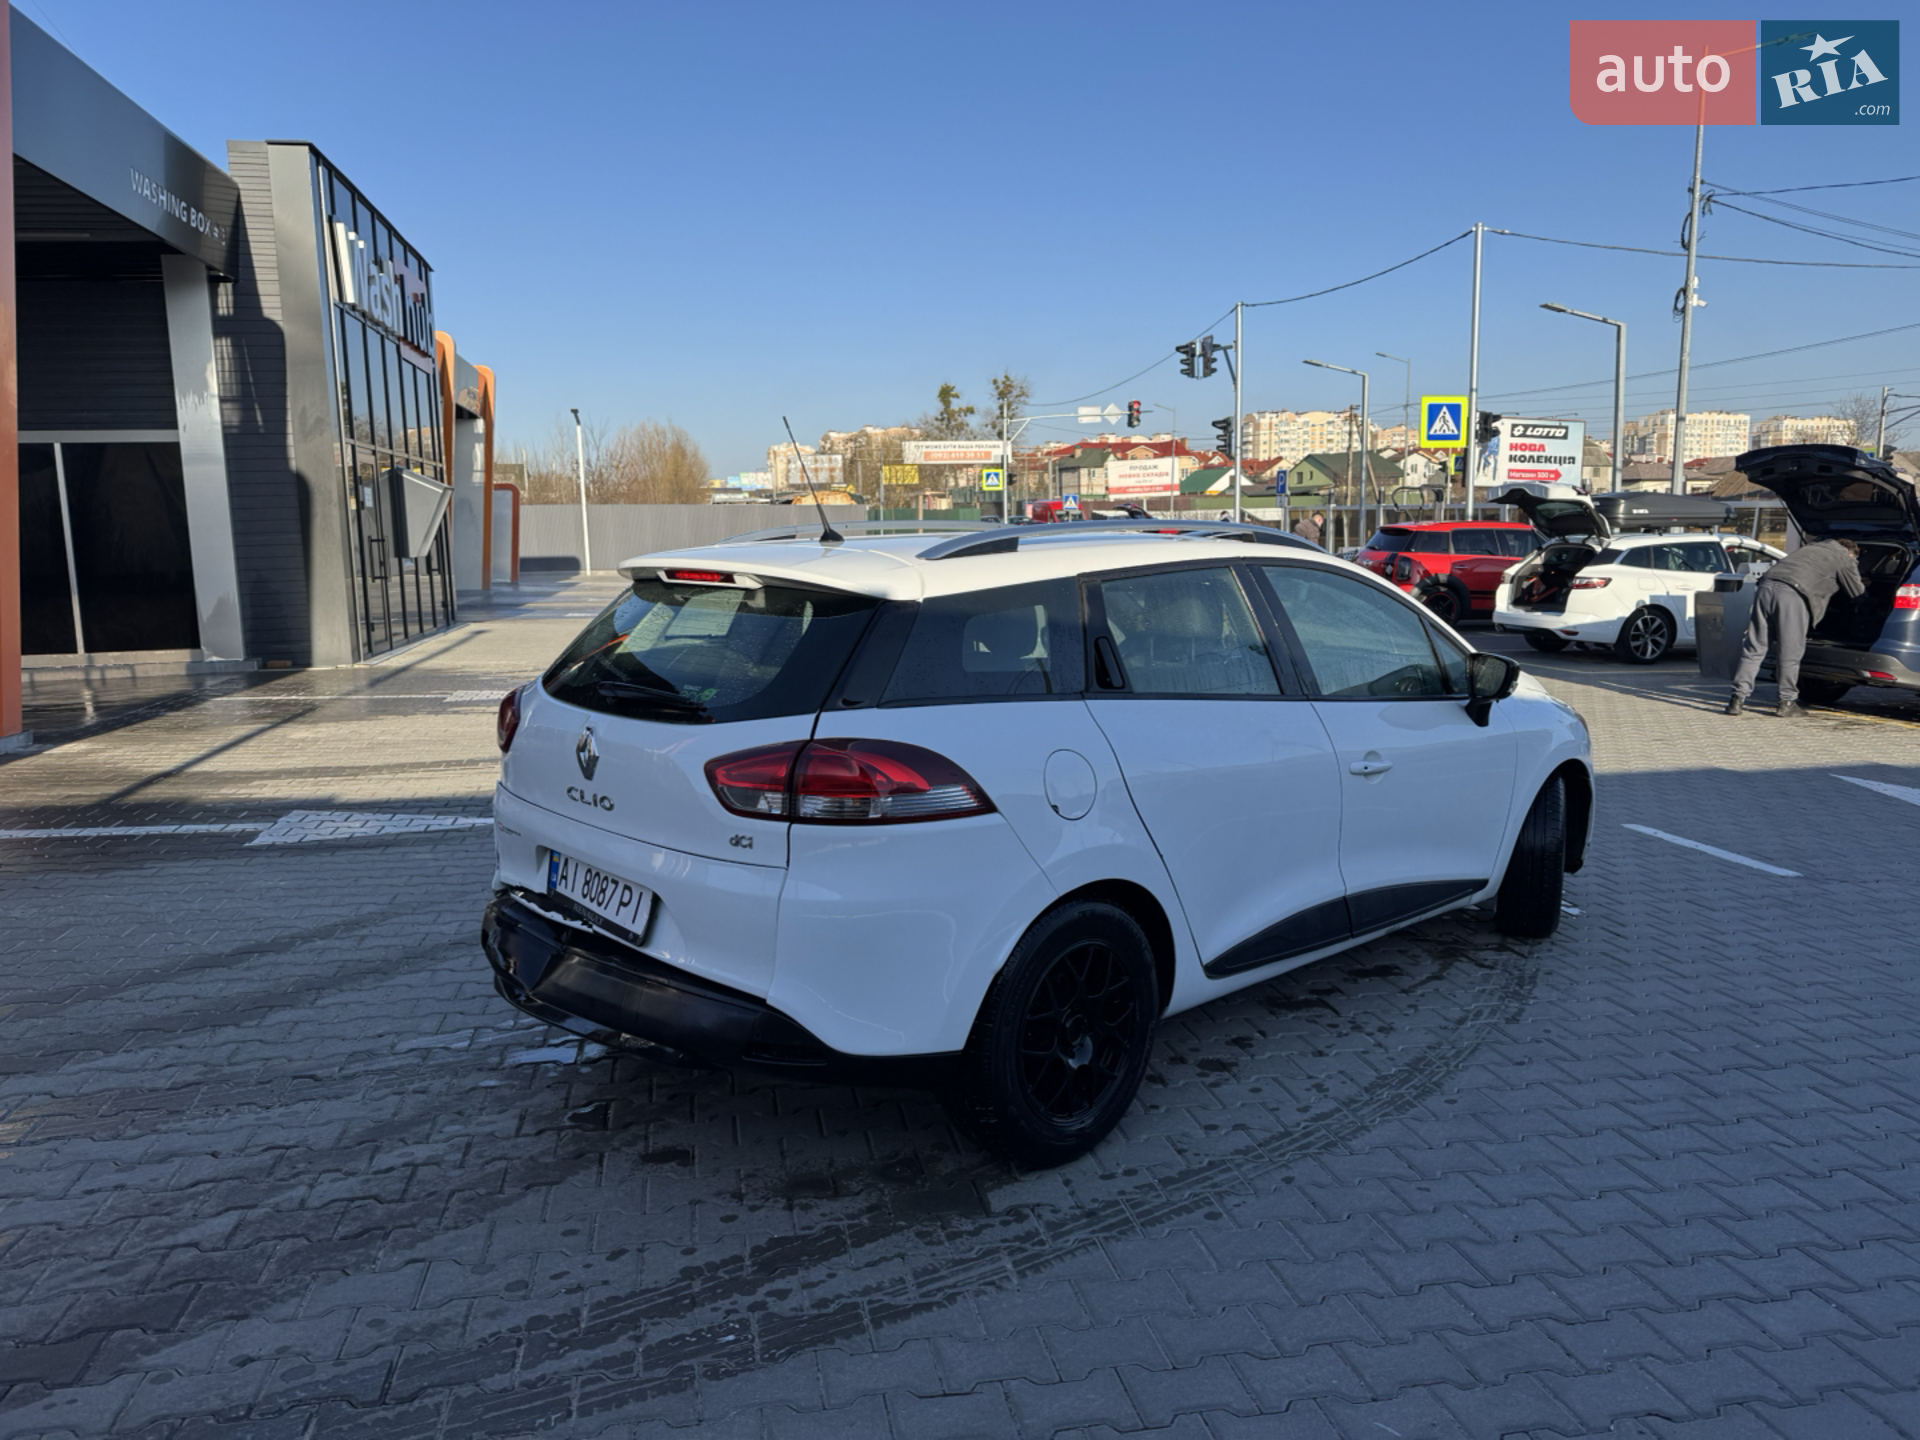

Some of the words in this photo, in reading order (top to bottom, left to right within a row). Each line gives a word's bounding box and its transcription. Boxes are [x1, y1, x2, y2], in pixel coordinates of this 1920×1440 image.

[130, 167, 188, 223] WASHING
[190, 207, 211, 237] BOX
[1526, 426, 1567, 437] LOTTO
[1509, 442, 1546, 452] НОВА
[1508, 454, 1576, 466] КОЛЕКЦІЯ
[1278, 472, 1285, 493] P
[566, 786, 615, 812] CLIO
[558, 857, 579, 893] AI
[581, 867, 620, 911] 8087
[615, 883, 643, 925] PI
